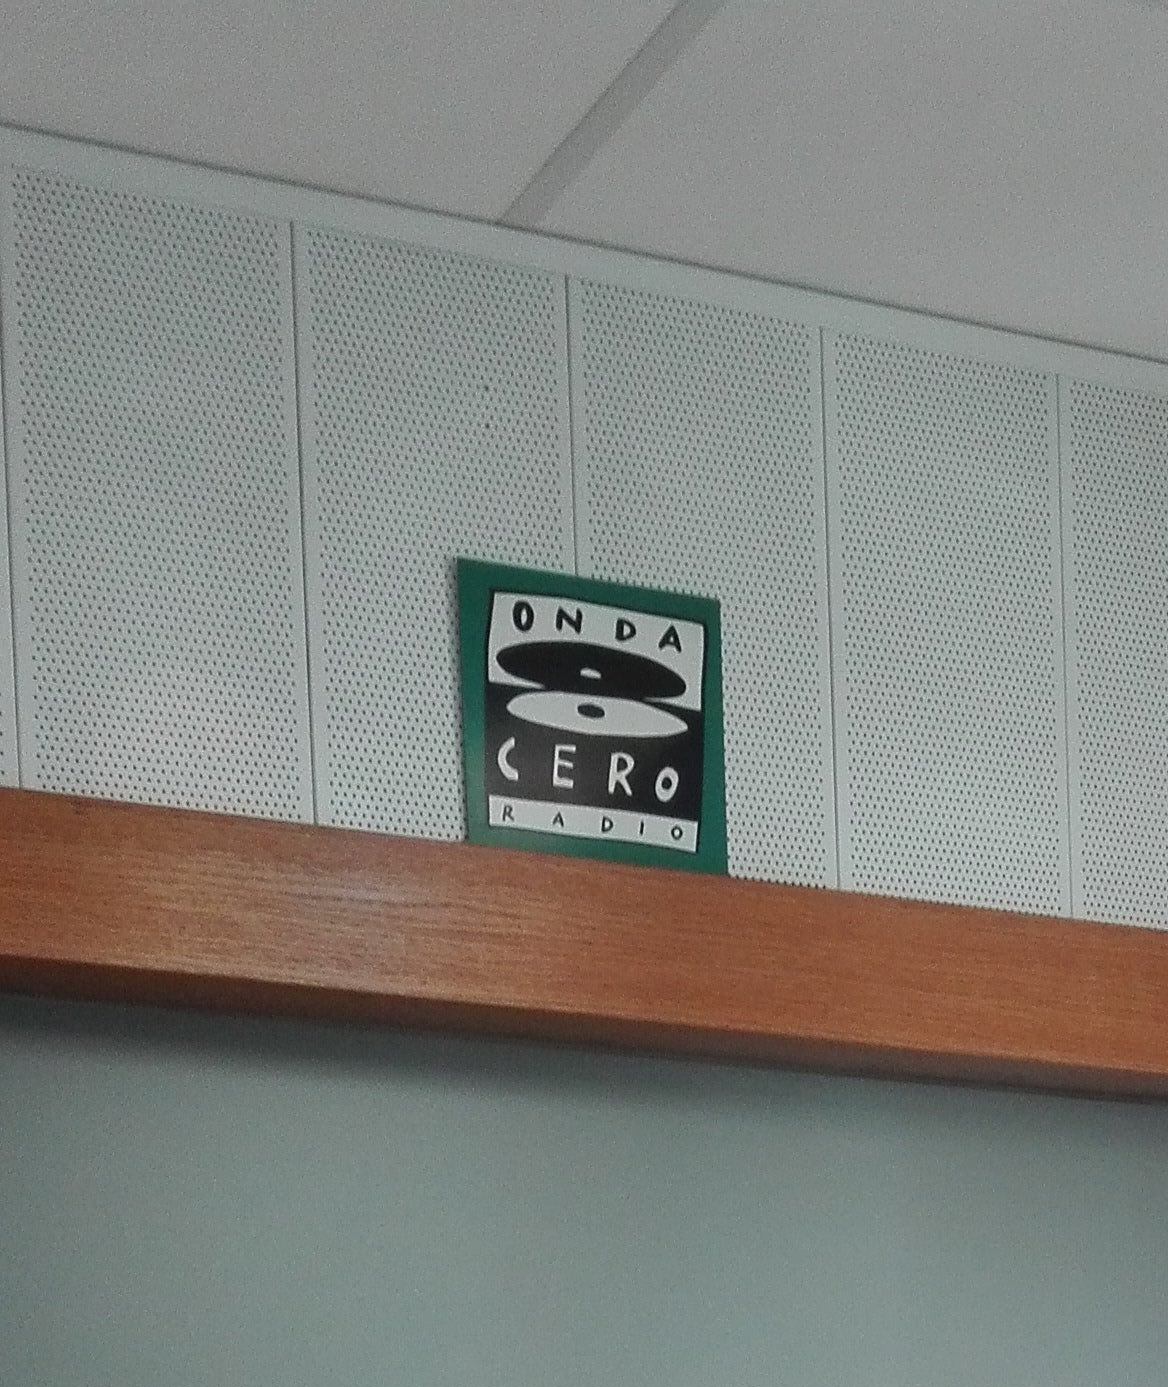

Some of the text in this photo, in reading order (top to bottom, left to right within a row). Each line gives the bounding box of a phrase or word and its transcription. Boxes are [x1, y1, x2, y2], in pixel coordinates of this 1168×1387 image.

[512, 600, 682, 653] ONDA
[497, 737, 680, 803] CERO
[502, 806, 683, 840] RADIO
